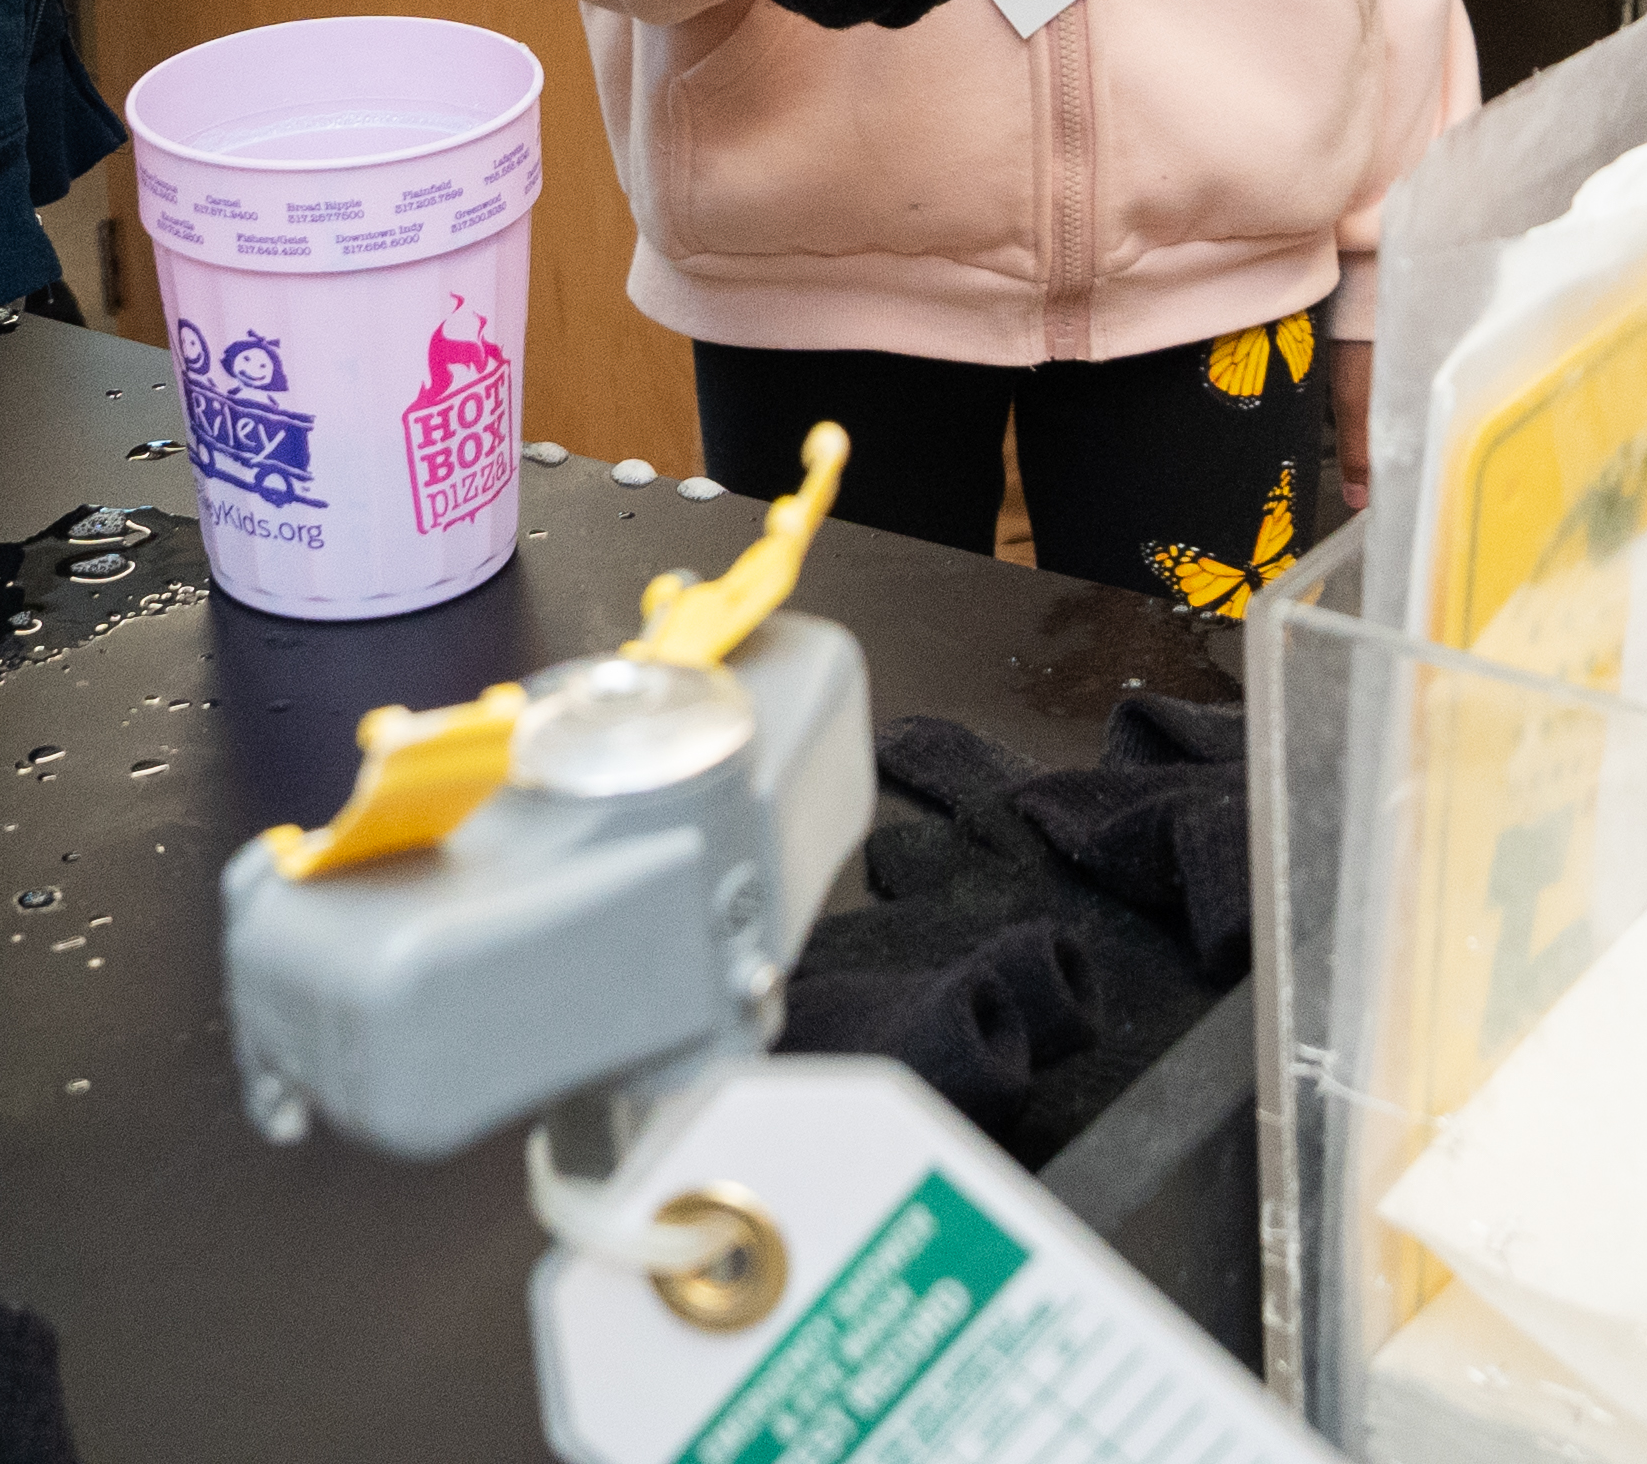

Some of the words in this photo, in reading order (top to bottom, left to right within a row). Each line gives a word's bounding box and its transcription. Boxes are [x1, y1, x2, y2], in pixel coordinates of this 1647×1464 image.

[286, 202, 321, 213] Broad
[402, 179, 452, 201] Plainfield
[335, 228, 396, 244] Downtown
[398, 222, 424, 235] Indy
[190, 391, 286, 465] Riley
[414, 371, 506, 450] HOT
[420, 409, 506, 489] BOX
[426, 451, 508, 529] pizza
